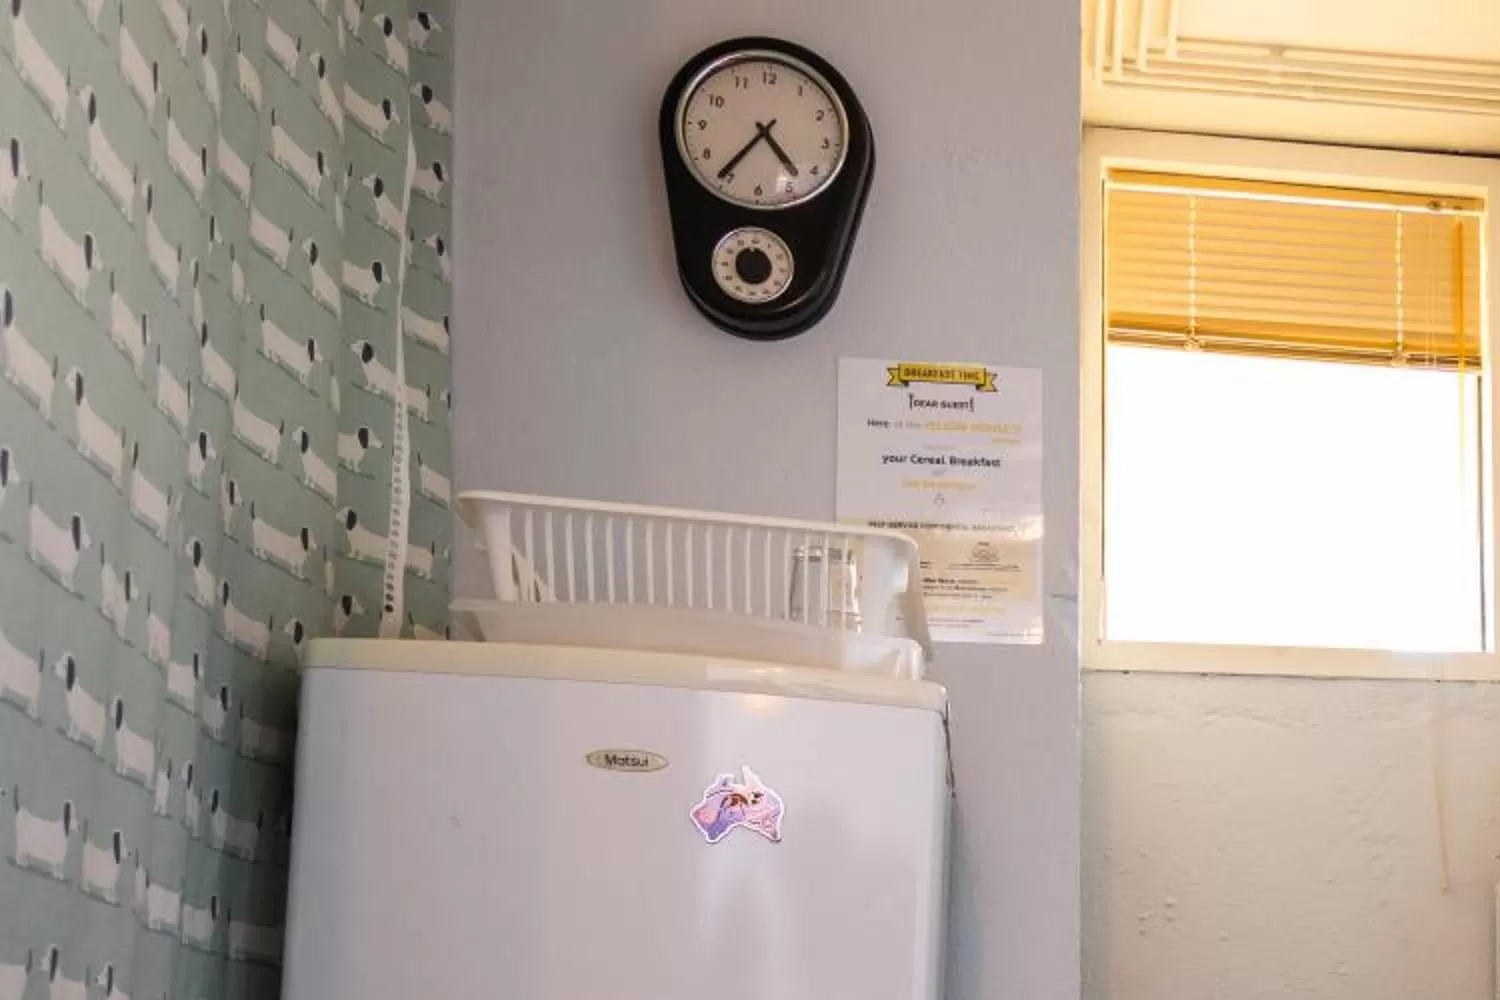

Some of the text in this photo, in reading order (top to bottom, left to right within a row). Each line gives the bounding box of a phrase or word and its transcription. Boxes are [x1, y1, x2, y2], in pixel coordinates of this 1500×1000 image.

[735, 75, 748, 89] 11
[763, 72, 777, 84] 12
[797, 85, 803, 97] 1
[709, 94, 724, 108] 10
[815, 110, 825, 121] 2
[698, 120, 706, 131] 9
[820, 137, 829, 149] 3
[703, 148, 711, 160] 8
[808, 165, 818, 175] 4
[753, 185, 763, 196] 6
[785, 181, 793, 193] 5
[903, 367, 981, 380] BREAKFAST TIME
[881, 454, 1001, 467] your Cereal Breakfast
[605, 753, 649, 767] Matsui
